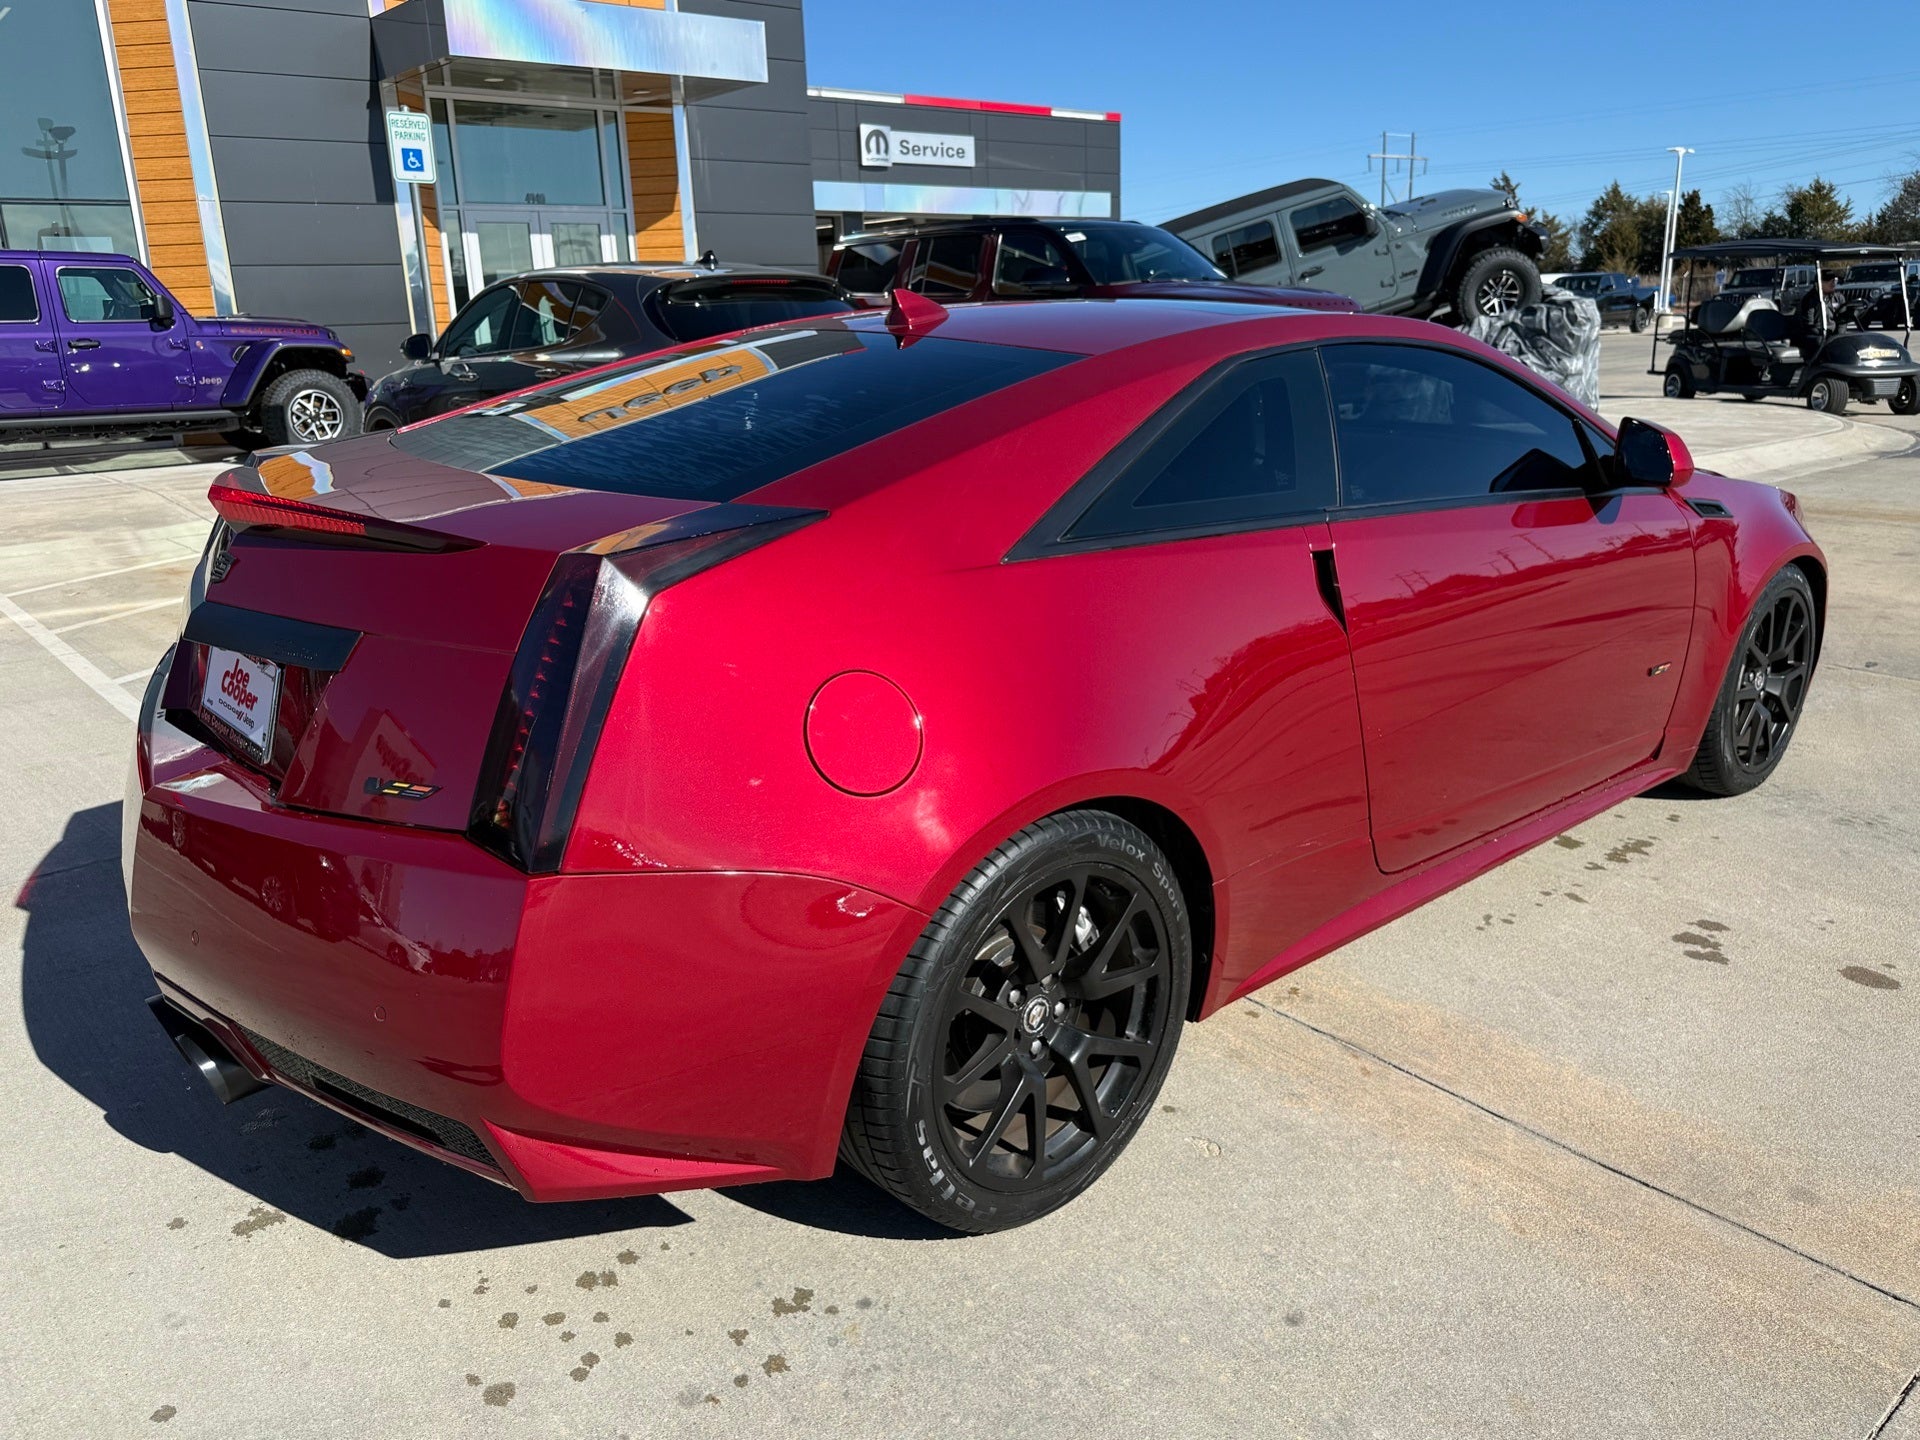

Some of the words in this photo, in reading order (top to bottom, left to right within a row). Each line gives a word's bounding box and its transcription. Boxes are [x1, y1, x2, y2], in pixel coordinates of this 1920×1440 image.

[390, 119, 427, 130] RESERVED
[394, 131, 426, 142] PARKING
[899, 139, 966, 159] Service
[199, 376, 222, 386] Jeep
[230, 658, 250, 689] Joe
[221, 669, 259, 711] Cooper
[1098, 834, 1146, 862] Velox
[1152, 862, 1184, 921] Sport
